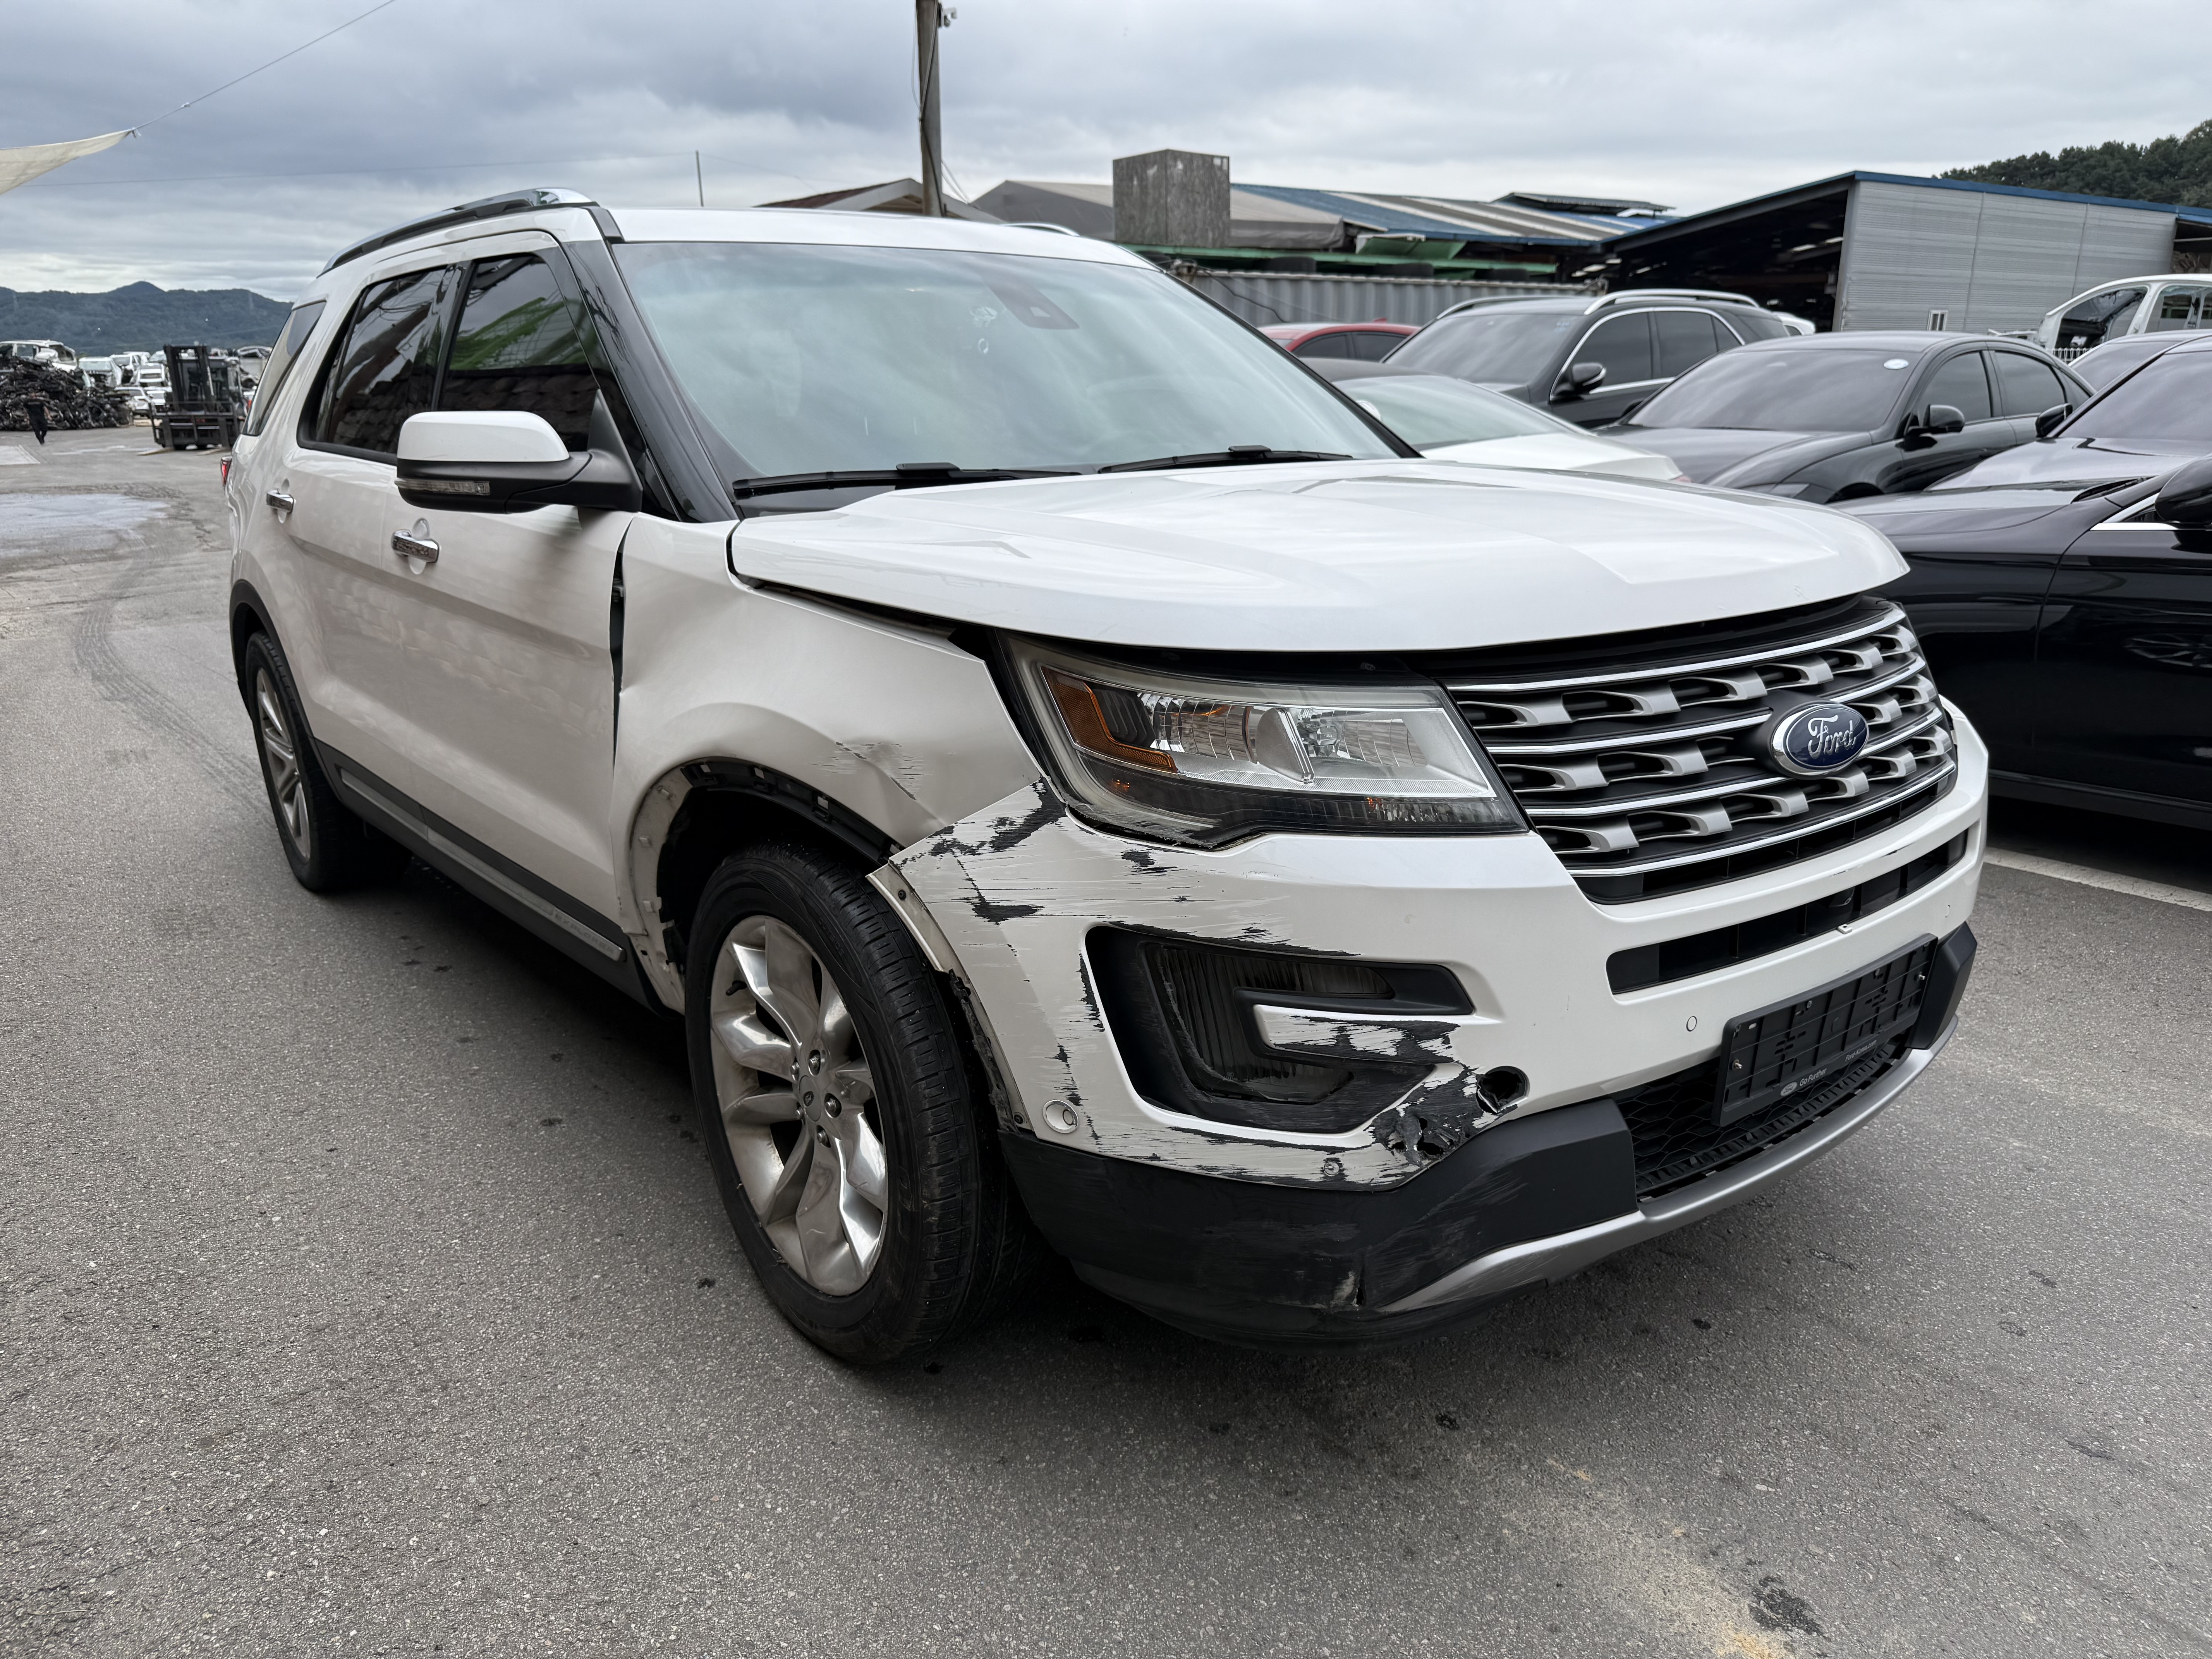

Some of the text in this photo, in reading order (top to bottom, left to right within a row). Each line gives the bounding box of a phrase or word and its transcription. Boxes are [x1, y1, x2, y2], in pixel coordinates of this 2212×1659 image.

[1808, 714, 1856, 759] Ford
[1800, 1068, 1827, 1086] Go Further
